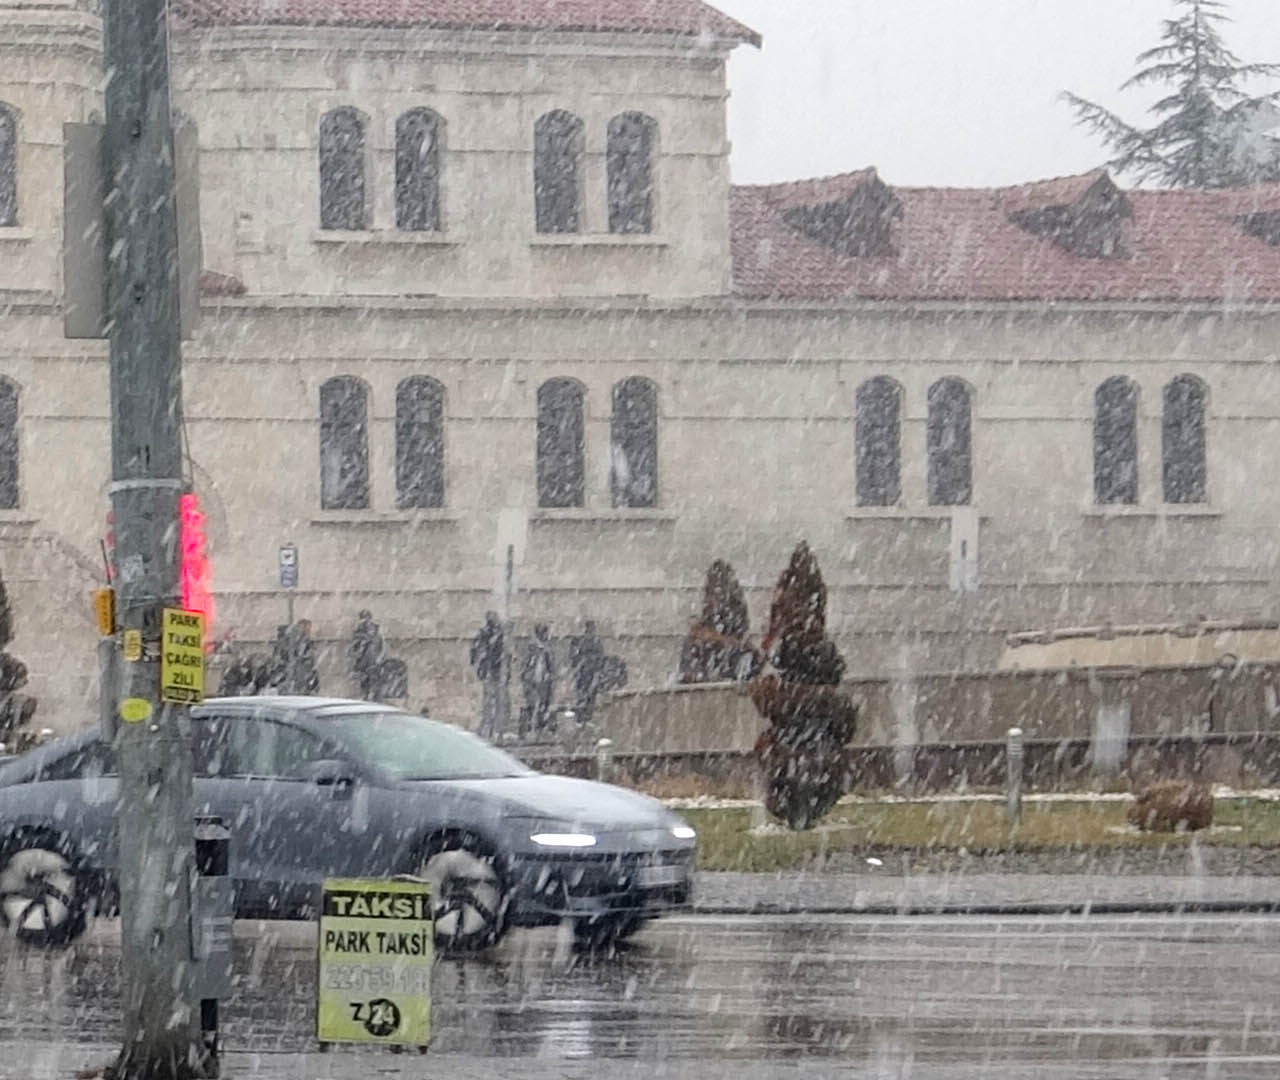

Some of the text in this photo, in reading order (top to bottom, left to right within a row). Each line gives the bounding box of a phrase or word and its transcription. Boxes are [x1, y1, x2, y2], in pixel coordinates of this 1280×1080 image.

[170, 613, 200, 628] PARK
[331, 895, 424, 918] TAKSİ
[325, 928, 427, 956] PARK TAKSİ
